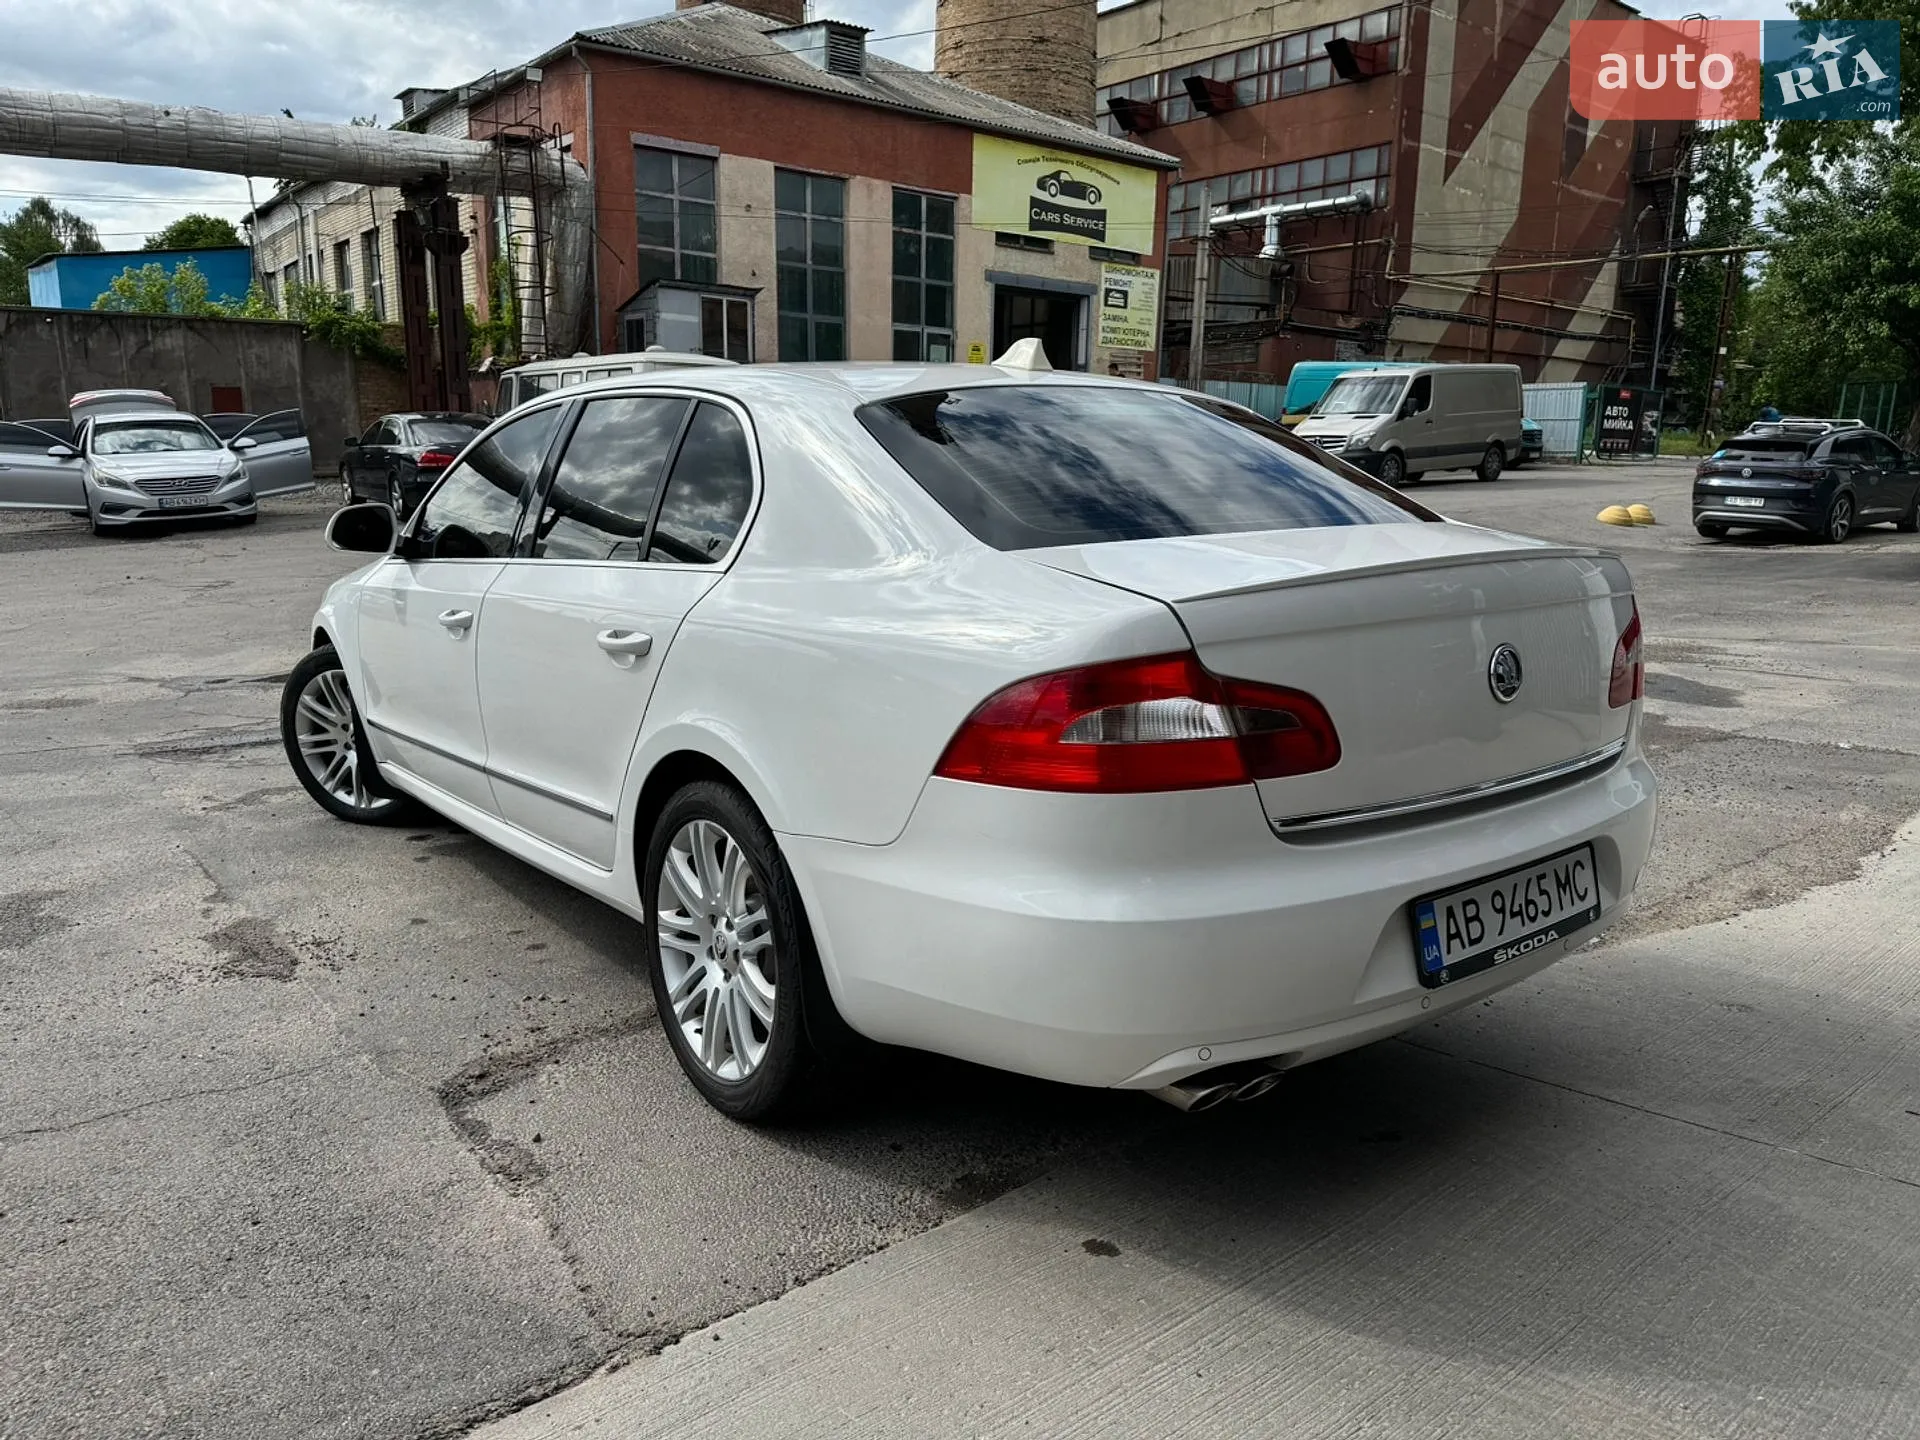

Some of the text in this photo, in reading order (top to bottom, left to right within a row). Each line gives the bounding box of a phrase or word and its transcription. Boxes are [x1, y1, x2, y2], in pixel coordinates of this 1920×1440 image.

[1604, 405, 1629, 417] АВТО
[1603, 417, 1634, 430] МИЙКА
[1446, 859, 1589, 955] AB 9465 MC
[1424, 944, 1440, 961] UA
